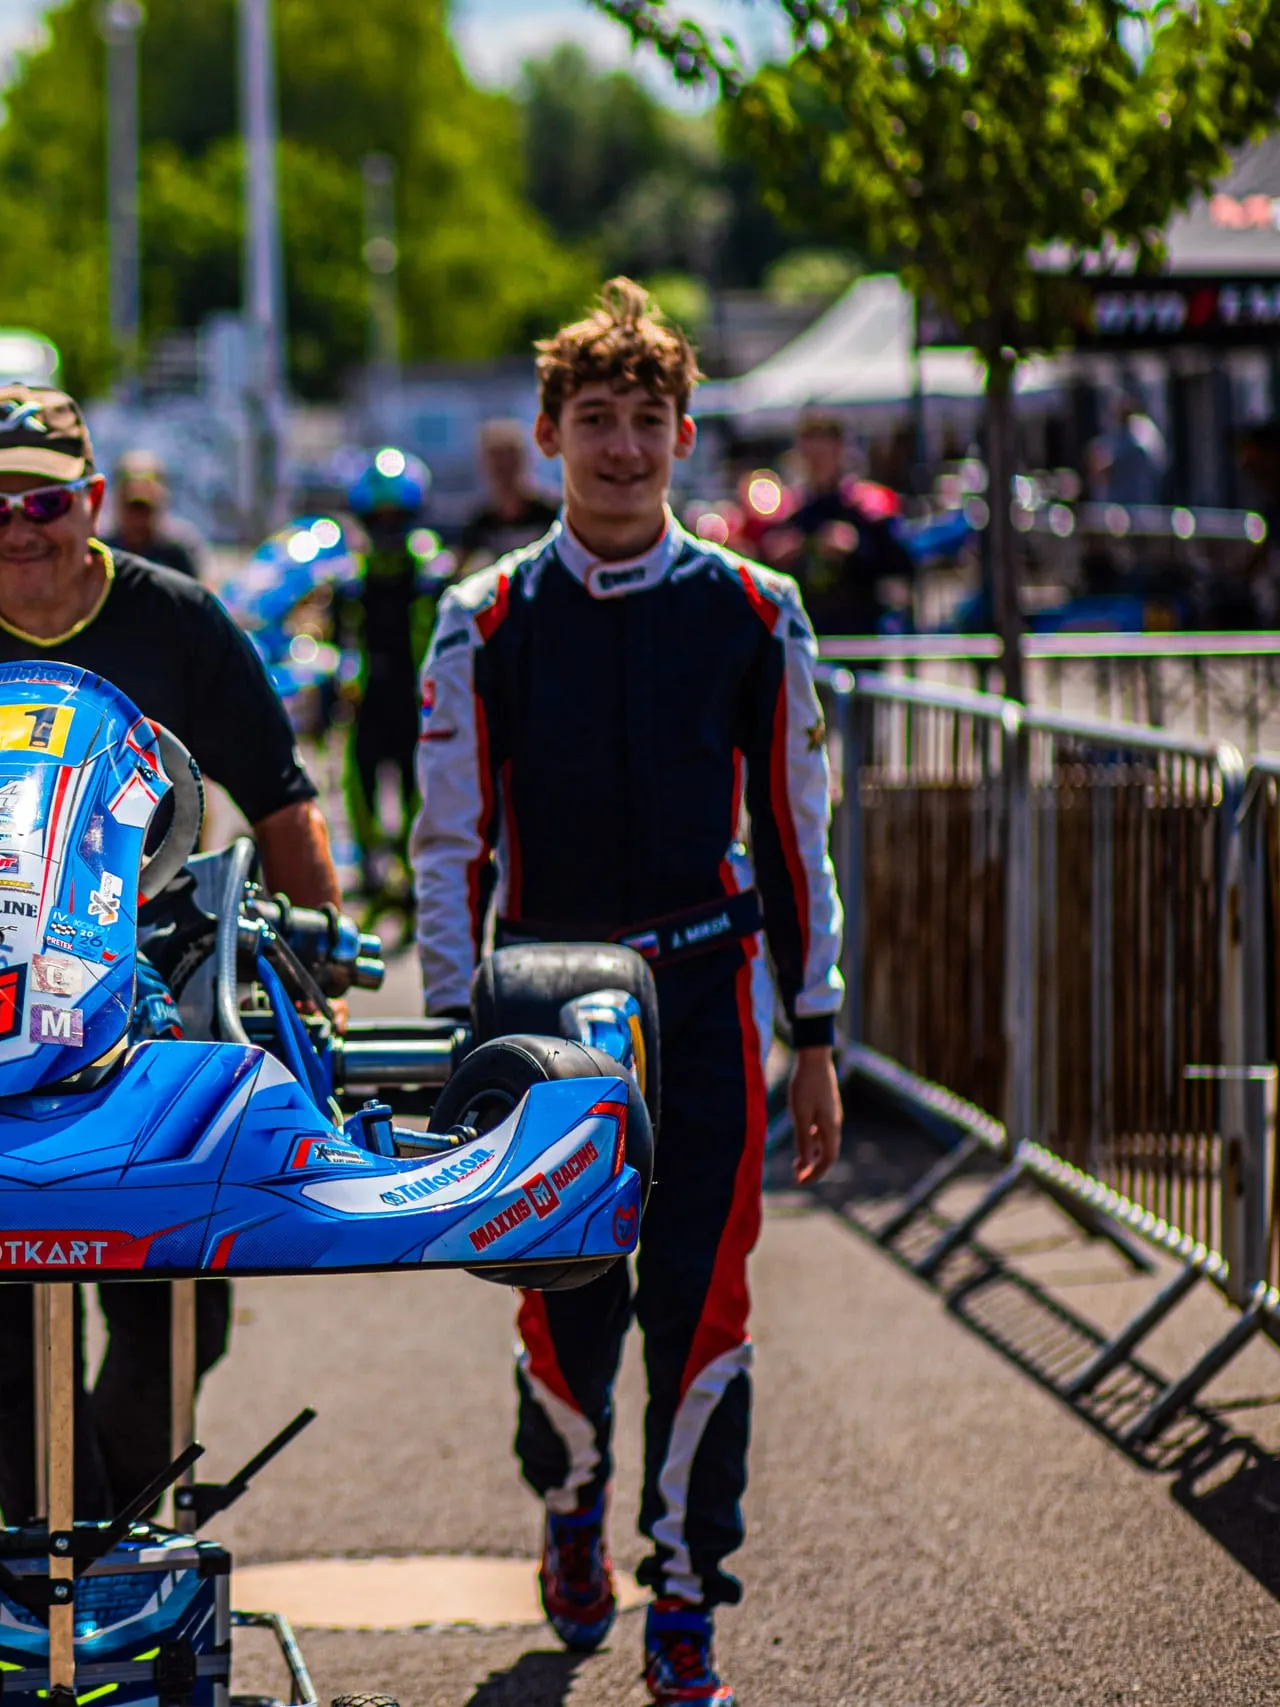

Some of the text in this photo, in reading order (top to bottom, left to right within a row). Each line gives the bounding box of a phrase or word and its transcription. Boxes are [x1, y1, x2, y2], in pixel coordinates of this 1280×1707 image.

[41, 1010, 71, 1039] M
[393, 1148, 492, 1201] Tillotson
[468, 1197, 531, 1252] MAXXIS
[550, 1140, 599, 1190] RACING
